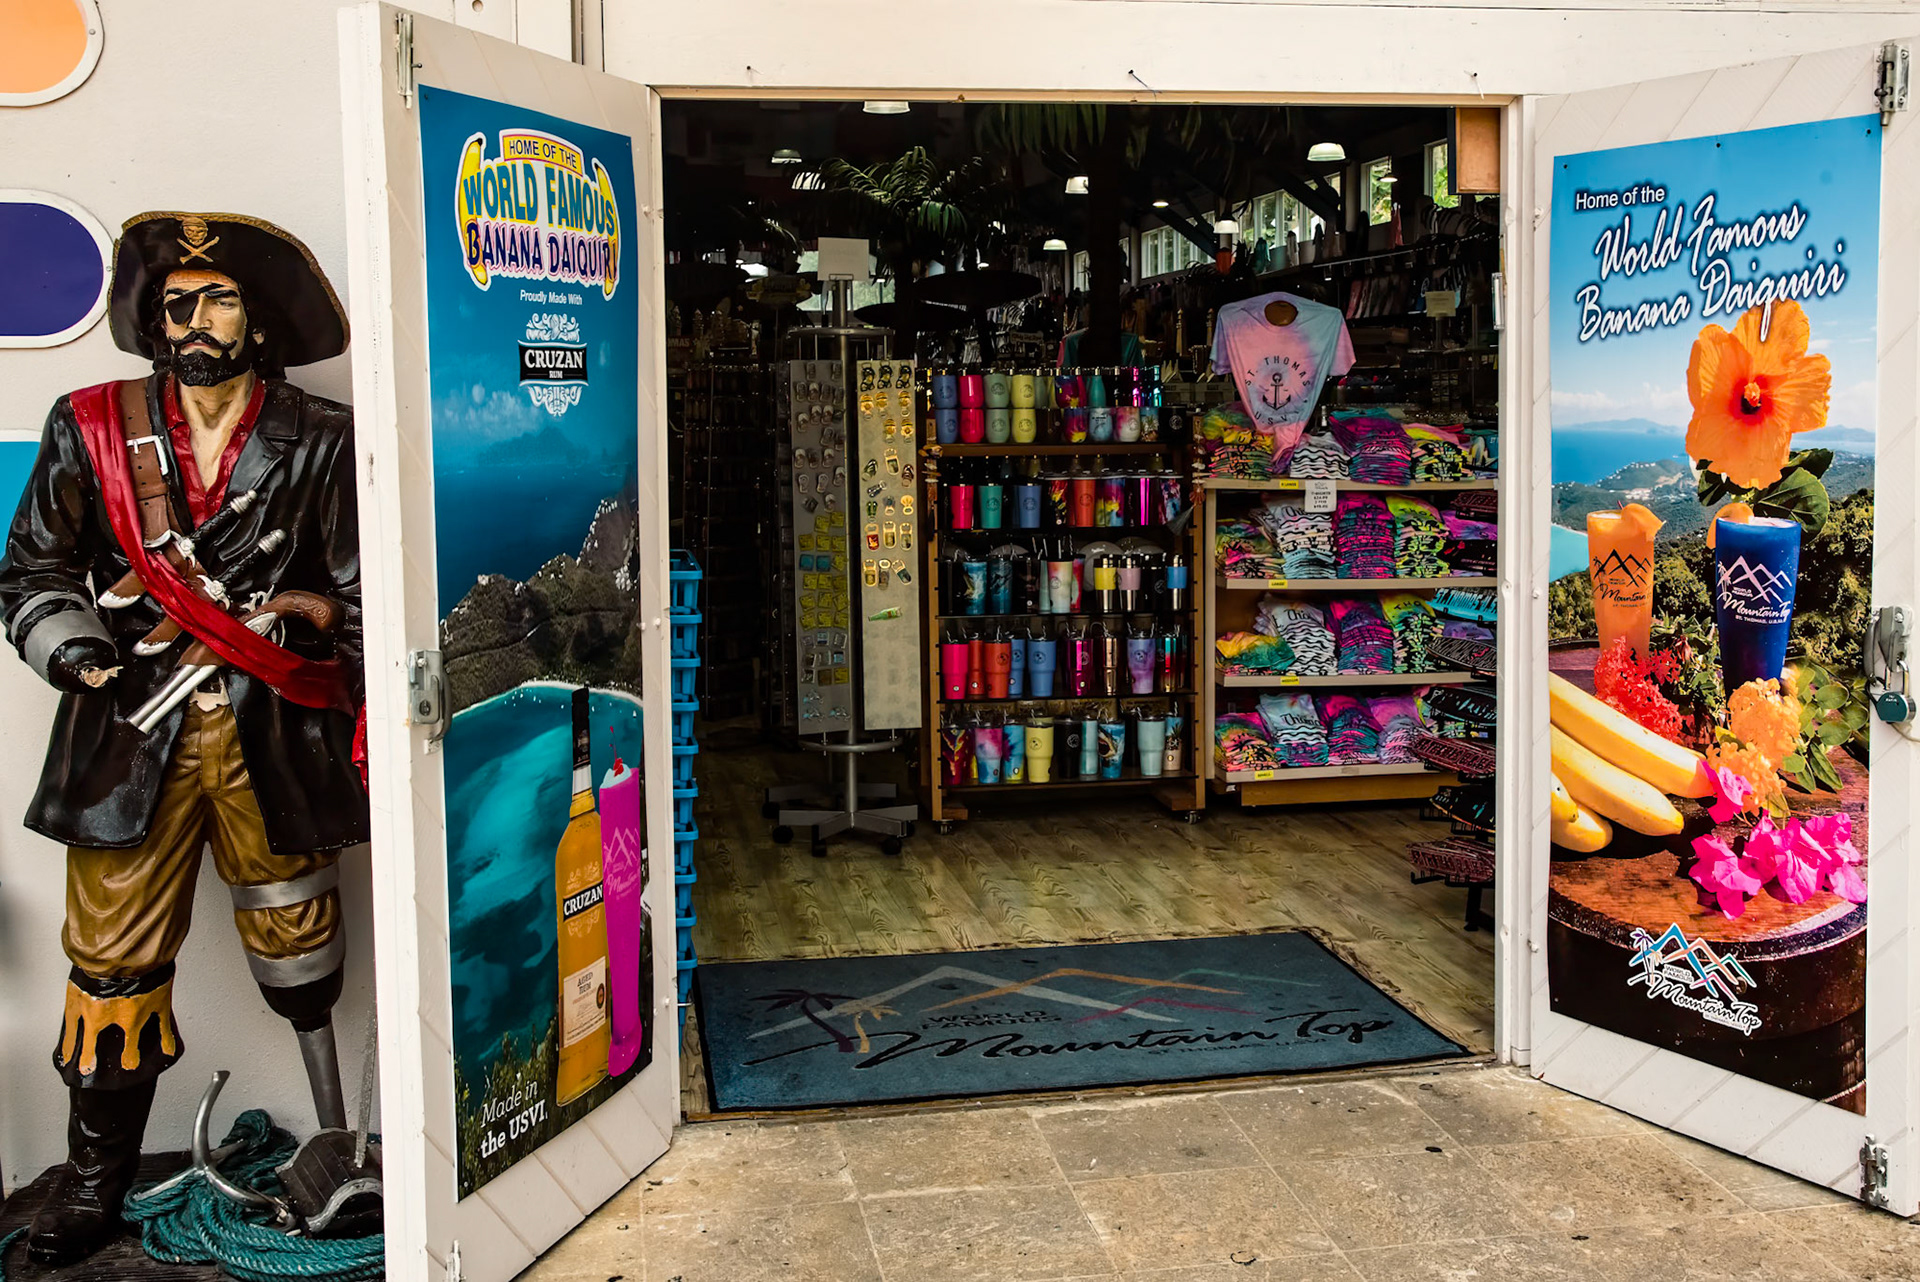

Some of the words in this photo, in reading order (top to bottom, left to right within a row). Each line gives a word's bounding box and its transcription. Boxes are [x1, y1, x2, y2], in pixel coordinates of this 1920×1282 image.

[509, 140, 539, 157] HOME
[543, 142, 557, 159] OF
[560, 146, 576, 168] THE
[463, 162, 538, 221] WORLD
[547, 167, 615, 237] FAMOUS
[1576, 191, 1618, 210] Home
[1623, 188, 1638, 205] of
[1641, 186, 1665, 203] the
[465, 222, 543, 272] BANANA
[548, 233, 617, 281] DAIQUIRI
[1594, 205, 1683, 281] World
[1687, 195, 1807, 276] Famous
[520, 289, 547, 305] Proudly
[549, 292, 567, 304] Made
[568, 293, 582, 305] With
[1577, 285, 1690, 342] Banana
[1700, 243, 1846, 342] Daiquiri
[525, 349, 583, 369] CRUZAN
[1264, 355, 1311, 387] THOMAS
[549, 370, 563, 378] RUM
[1717, 591, 1779, 617] Mountain
[563, 884, 603, 916] CRUZAN
[1664, 969, 1693, 982] FAMOUS
[1665, 965, 1691, 976] WORLD
[928, 1010, 1047, 1023] WORLD
[1629, 973, 1733, 1022] Mountain
[1732, 1003, 1760, 1033] Top
[921, 1015, 1062, 1030] FAMOUS
[740, 1027, 1279, 1070] Mountain
[1264, 1009, 1394, 1044] Top
[481, 1084, 522, 1128] Made
[525, 1080, 538, 1101] in
[480, 1130, 506, 1158] the
